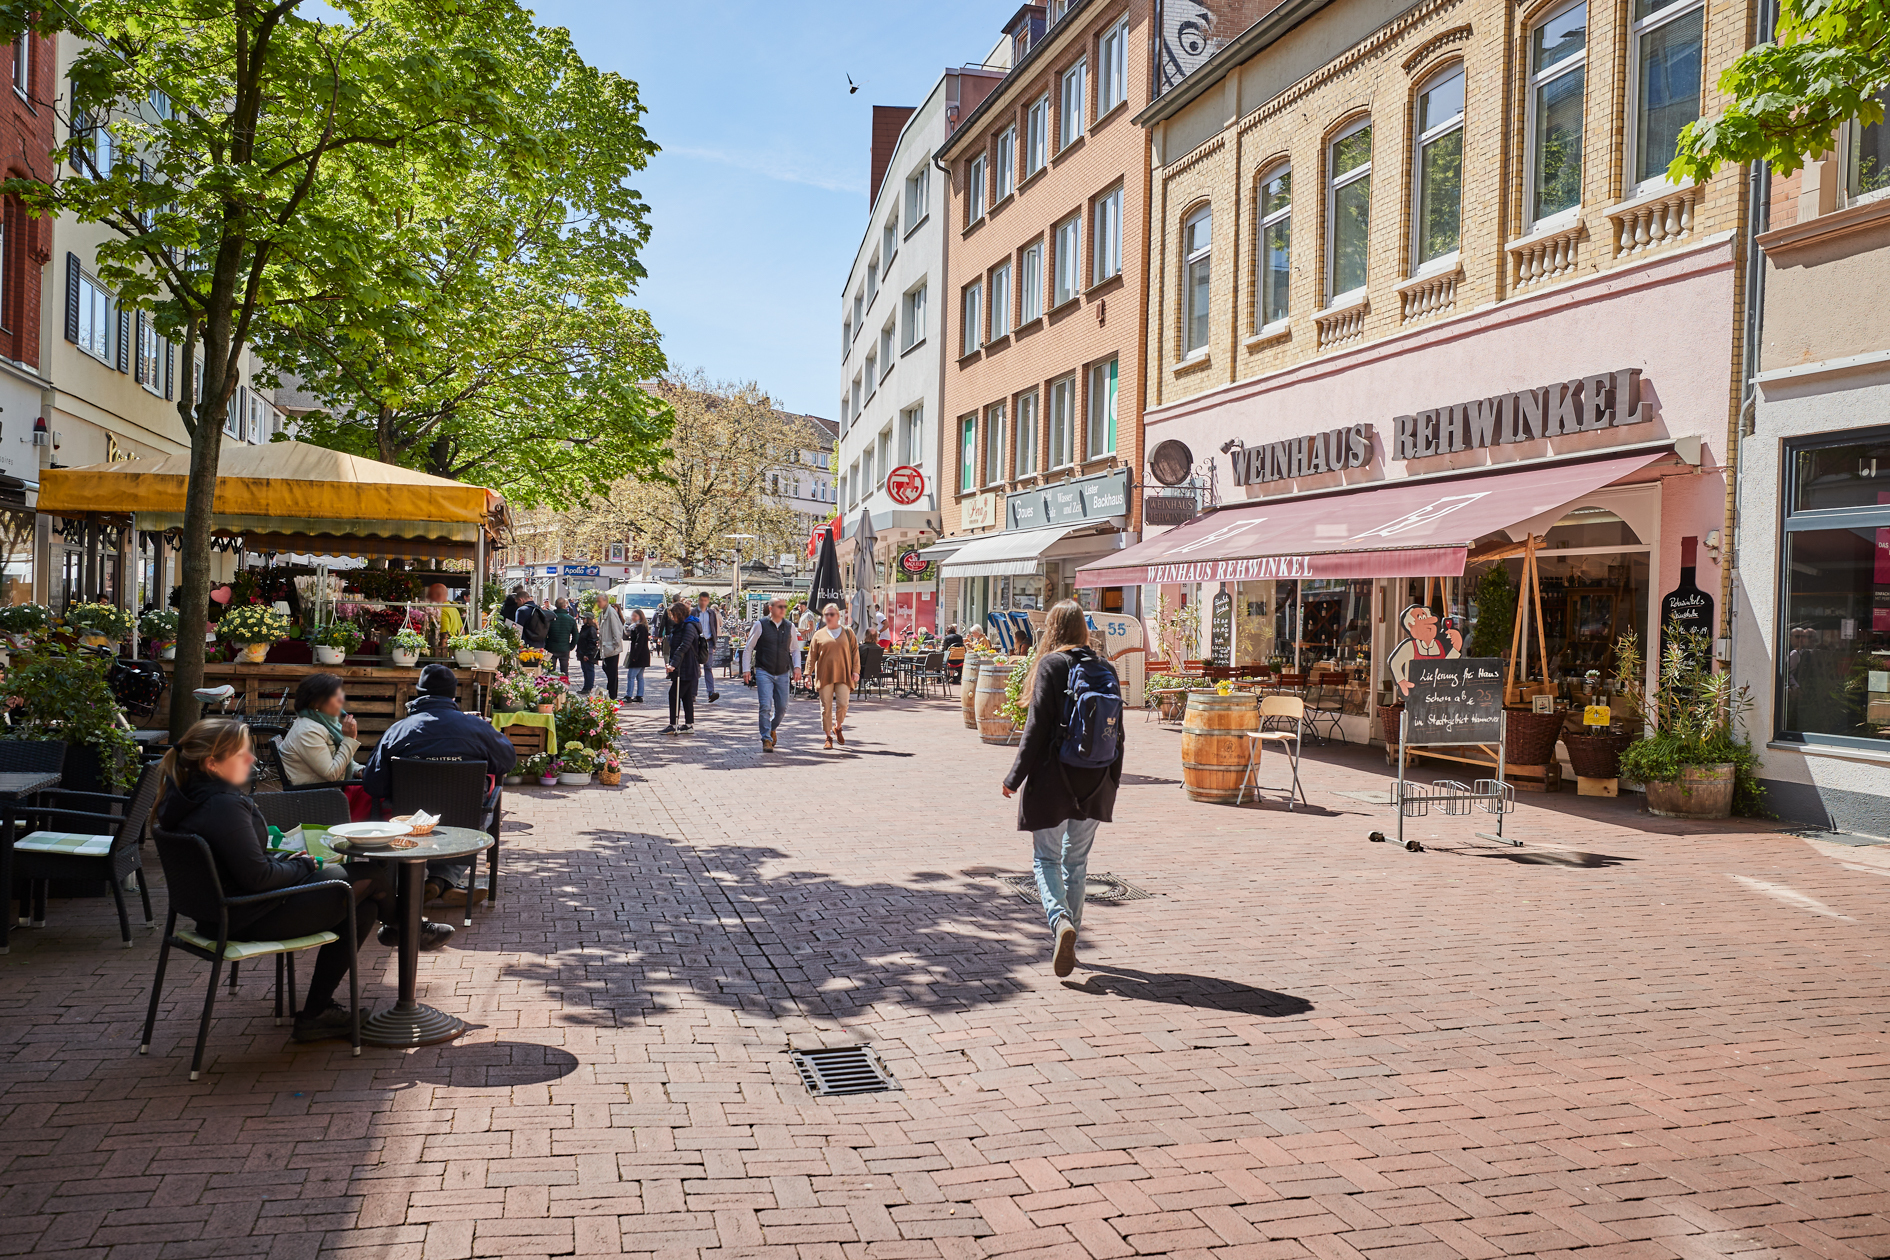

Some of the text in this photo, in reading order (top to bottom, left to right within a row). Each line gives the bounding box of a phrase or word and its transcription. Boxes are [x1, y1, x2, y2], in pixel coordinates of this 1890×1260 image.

[1231, 368, 1653, 487] WEINHAUS REHWINKEL
[1085, 485, 1099, 495] Lister
[1057, 493, 1073, 503] Wasser
[1093, 494, 1123, 509] Backhaus
[1063, 503, 1072, 514] und
[1149, 500, 1193, 510] WEINHAUS
[1147, 556, 1313, 582] WEINHAUS REHWINKEL
[1108, 622, 1126, 636] 55
[1420, 668, 1458, 687] Lieferung
[1478, 668, 1499, 678] Haus
[1454, 690, 1467, 702] ab
